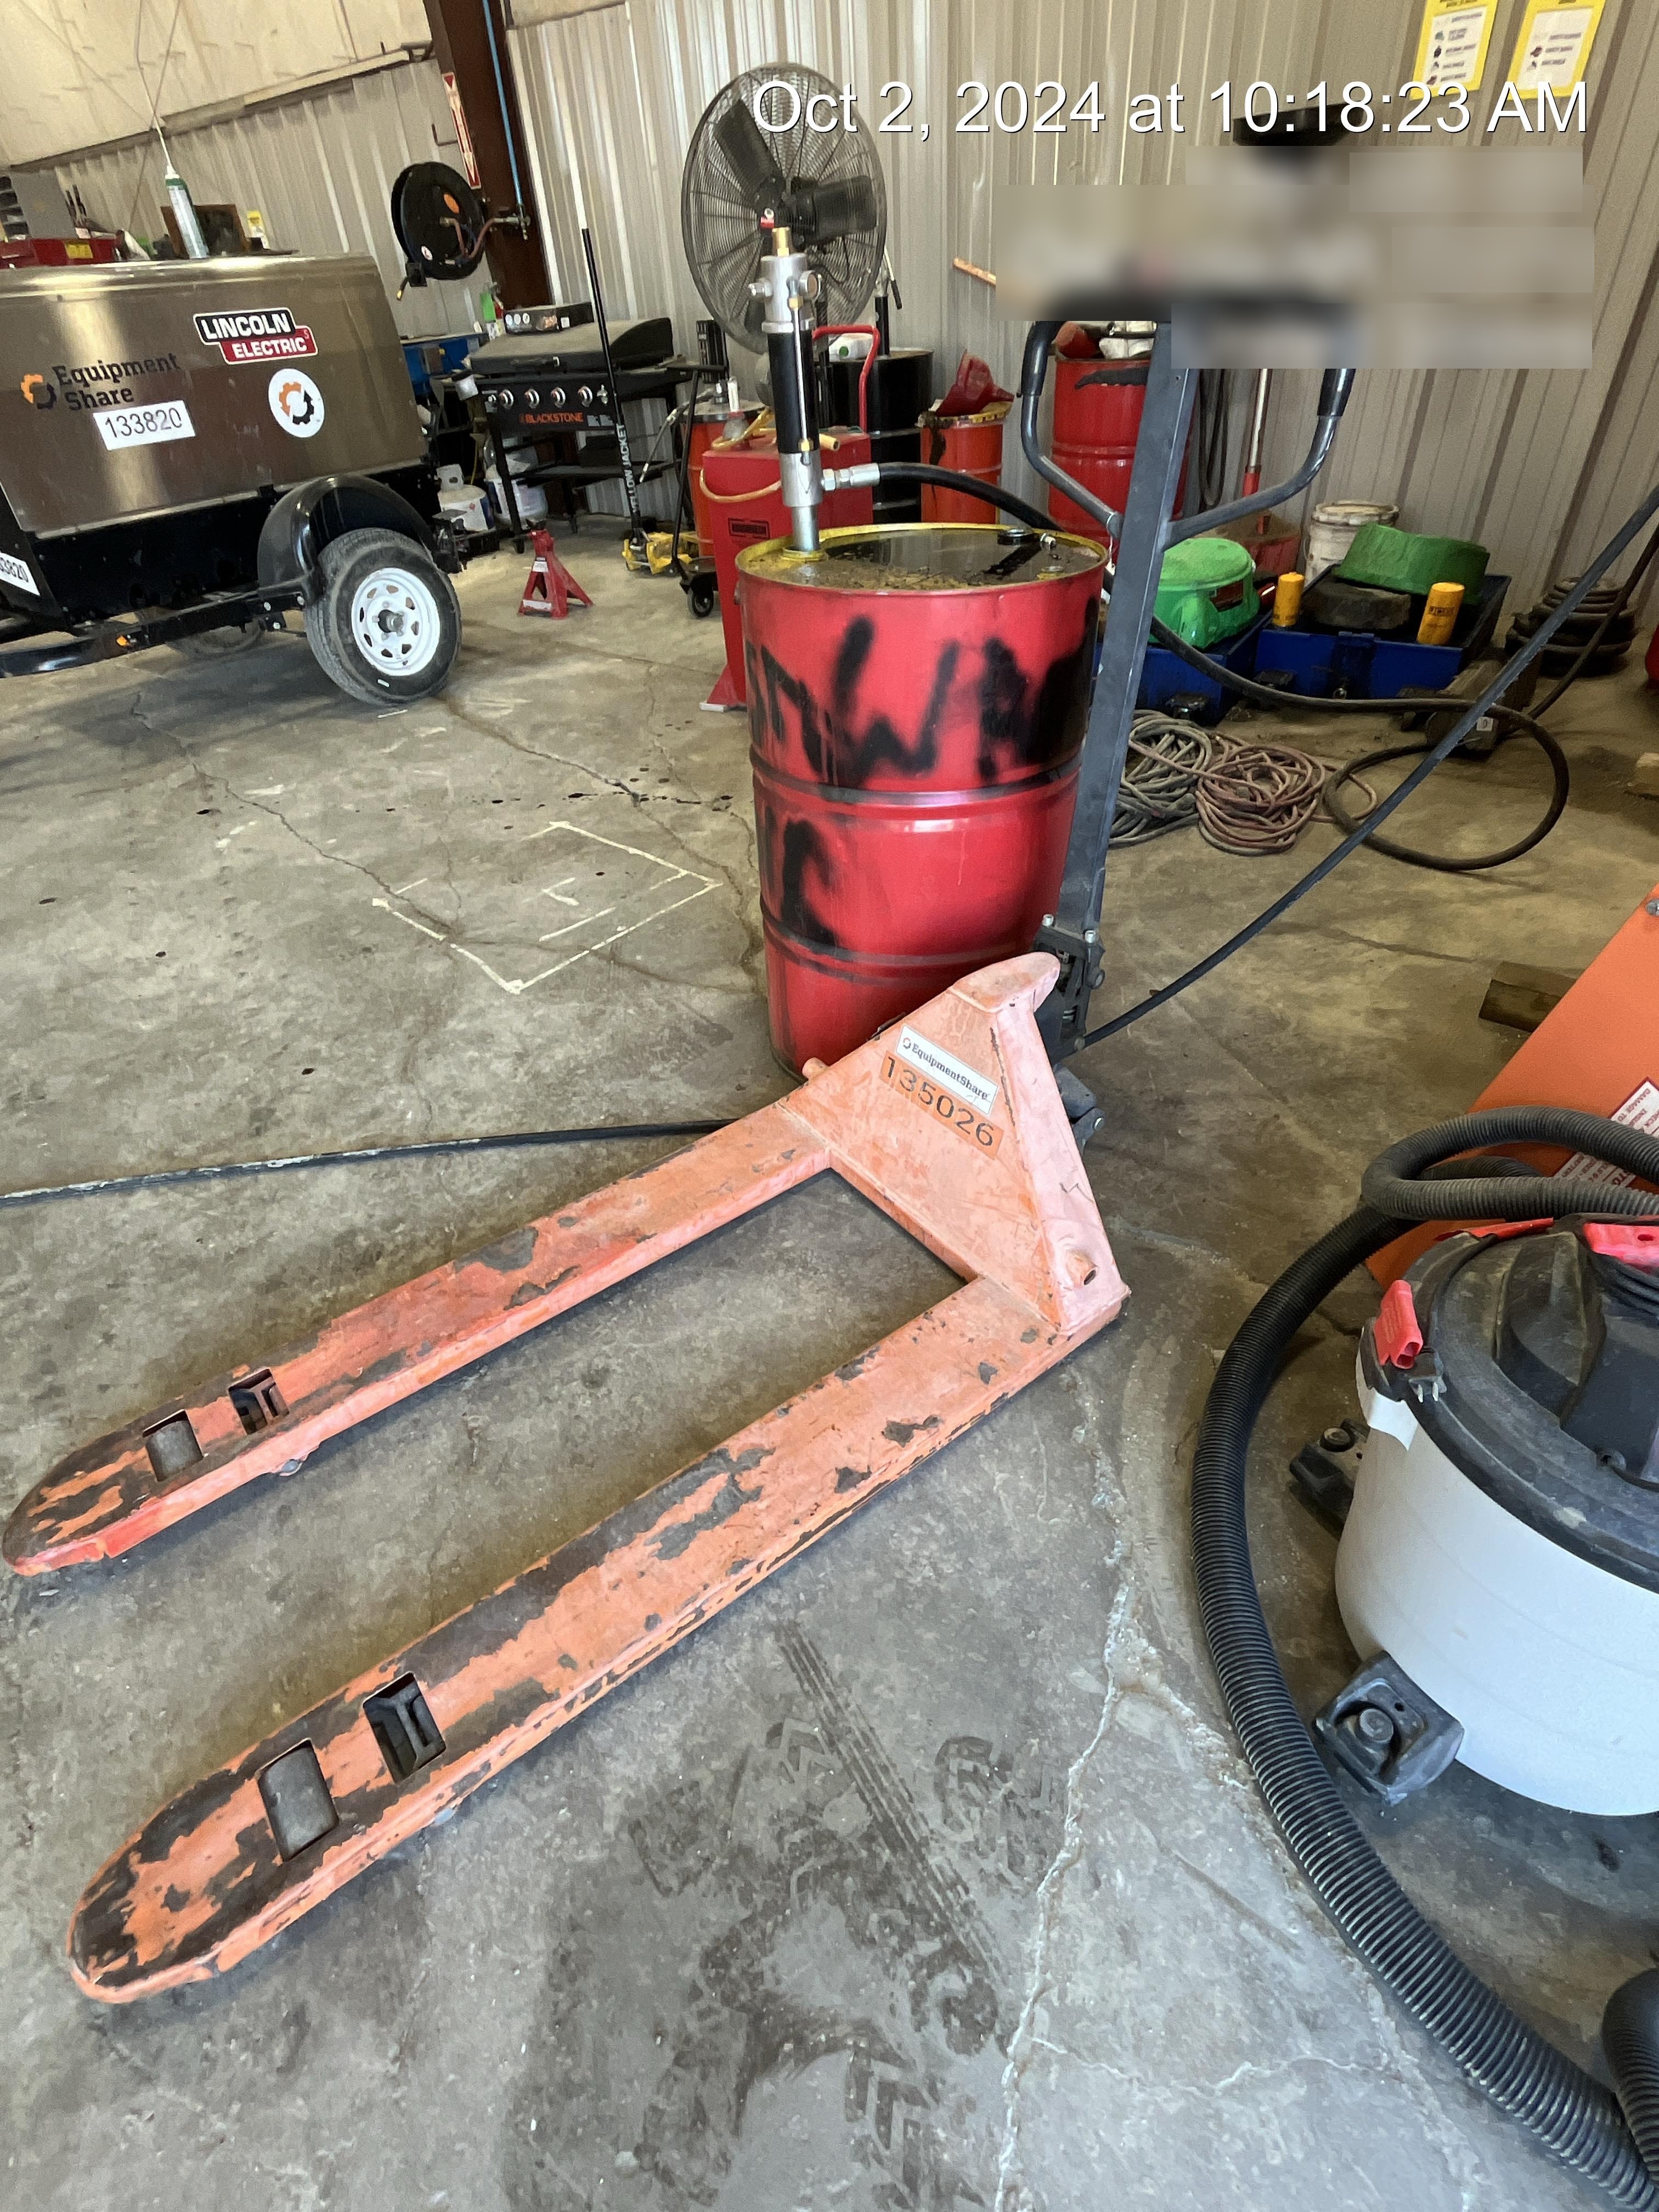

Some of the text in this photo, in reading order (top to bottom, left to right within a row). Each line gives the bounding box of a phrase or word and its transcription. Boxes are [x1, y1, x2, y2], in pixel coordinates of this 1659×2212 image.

[200, 313, 291, 340] LINCOLN
[231, 337, 307, 359] ELECTRIC
[52, 353, 181, 387] Equipment
[64, 387, 134, 411] Share
[105, 407, 183, 438] 133820
[525, 412, 584, 424] BLACKSTONE
[616, 423, 631, 466] JACKET
[911, 1042, 989, 1101] EquipmentShare
[887, 1056, 995, 1147] 135026
